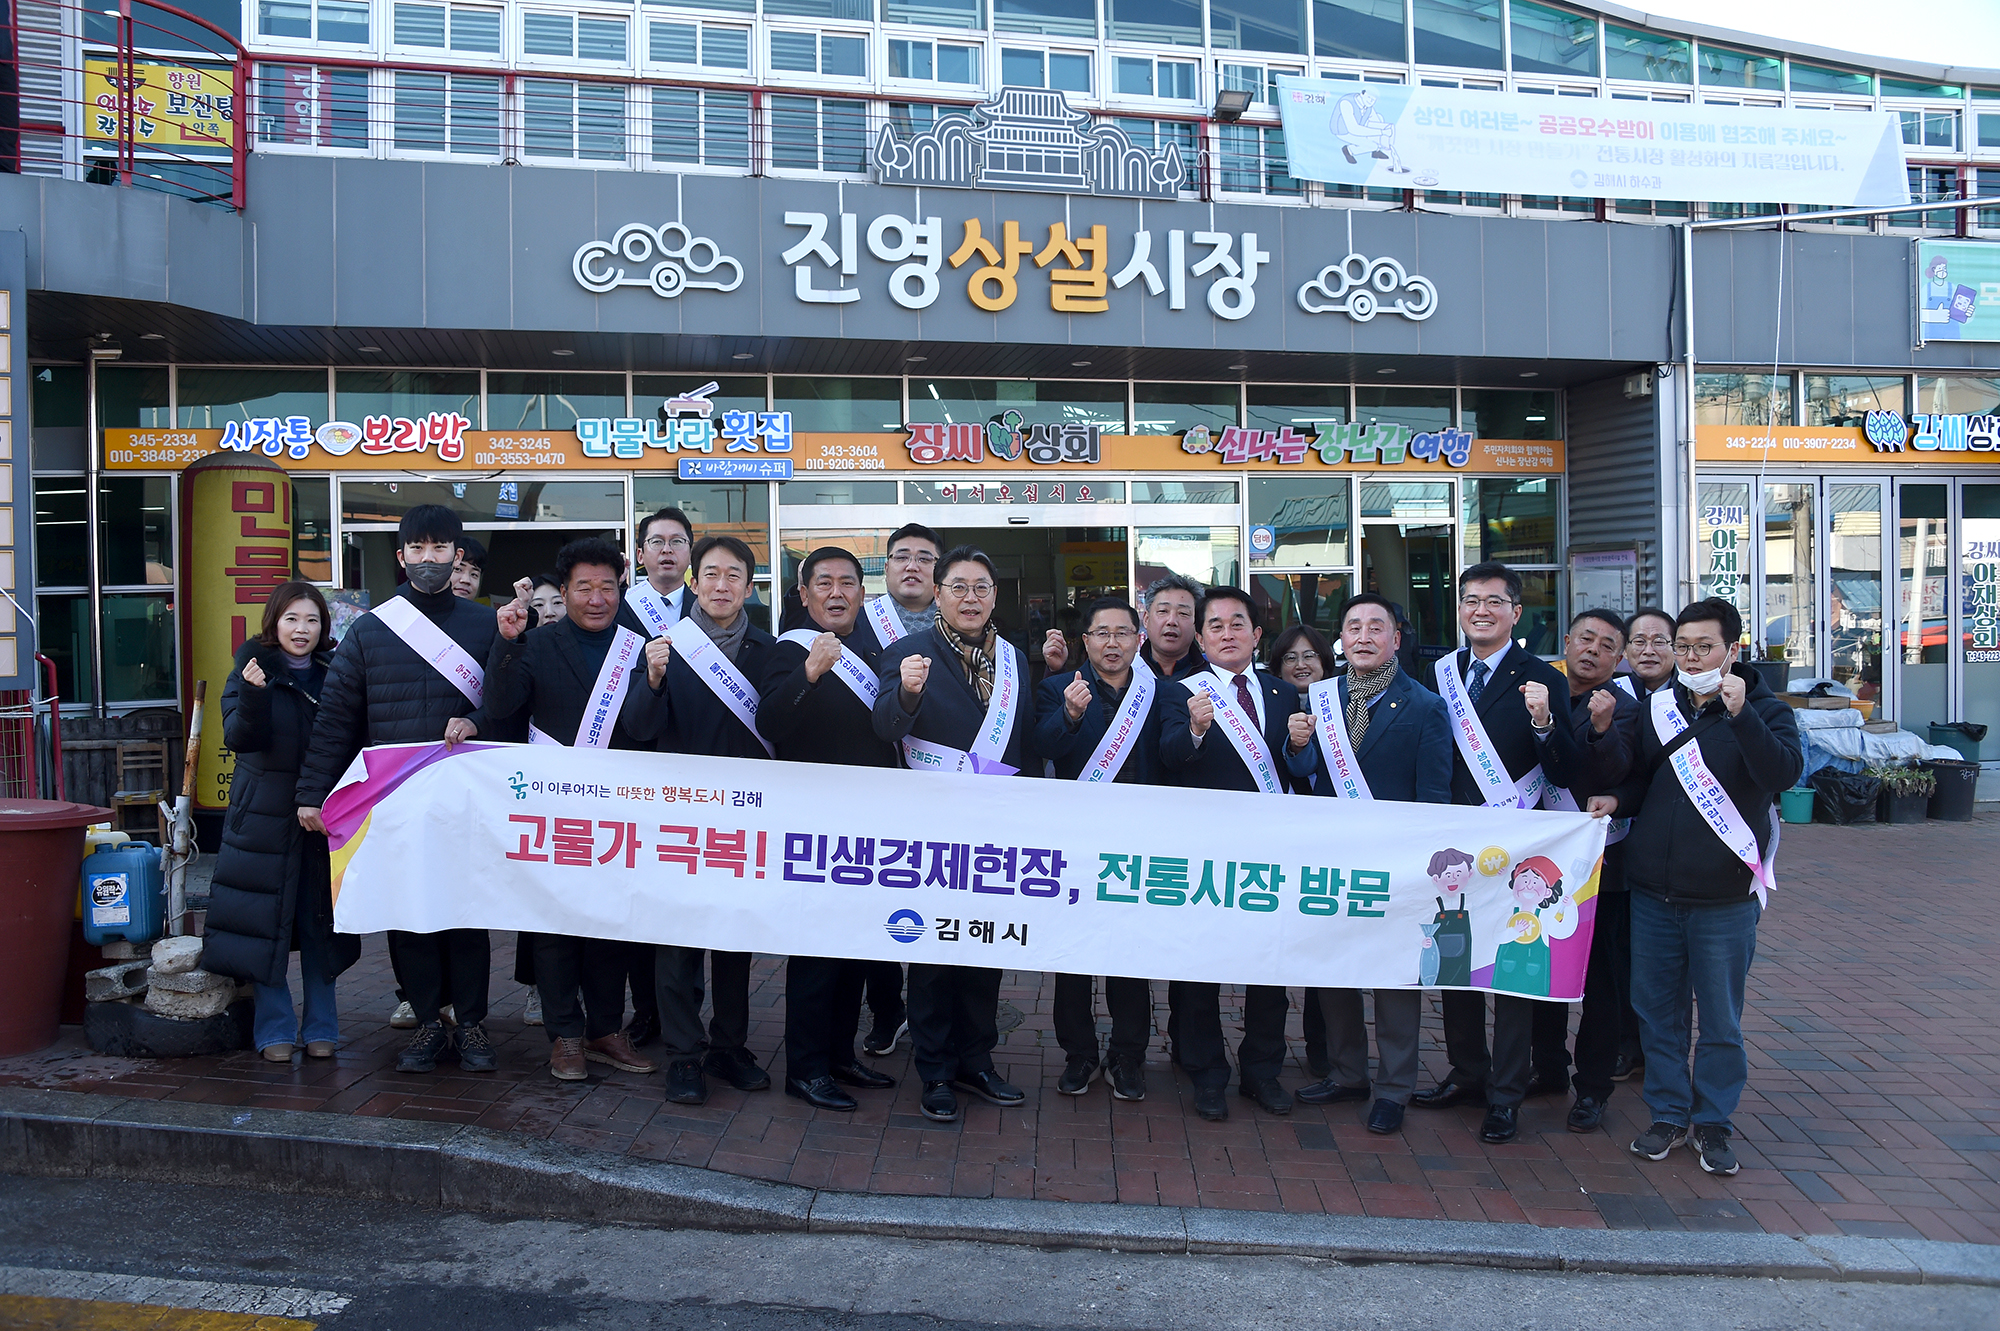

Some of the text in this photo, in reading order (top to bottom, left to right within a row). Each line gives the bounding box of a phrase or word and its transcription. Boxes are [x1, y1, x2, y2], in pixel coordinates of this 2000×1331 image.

[167, 71, 201, 90] 향원
[165, 93, 233, 121] 보신탕
[192, 121, 219, 136] 안쪽
[1413, 105, 1847, 147] 상인 여러분~ 공공오수받이 이용에 협조해 주세요~
[1488, 139, 1521, 157] 시장
[1596, 145, 1664, 166] 전통시장
[1669, 149, 1736, 168] 활성화의
[1742, 151, 1845, 172] 지름길입니다.
[1594, 173, 1662, 189] 김해시 하수과
[781, 210, 1270, 321] 진영상설시장
[129, 433, 198, 447] 345-2334
[221, 412, 471, 461] 시장통 보리밥
[489, 437, 552, 450] 342-3245
[577, 410, 793, 458] 민물나라 횟집
[905, 423, 1101, 463] 장씨 상회
[1726, 437, 1856, 450] 343-2234 010-3907-2234
[1912, 413, 2000, 451] 강씨상
[110, 448, 216, 463] 010-3848-233
[820, 446, 878, 458] 343-3604
[1215, 422, 1474, 467] 신나는 장난감 여행
[1526, 445, 1553, 455] 함께하는
[475, 452, 565, 466] 010-3553-0470
[706, 460, 786, 476] 바람개비 슈퍼
[806, 458, 886, 470] 010-9206-3604
[1495, 456, 1553, 467] 신나는 장난감 여행
[942, 484, 1095, 503] 어서오십시오
[1705, 506, 1743, 526] 강씨
[1969, 541, 2000, 559] 강씨
[1972, 563, 1997, 648] 야채상회
[1967, 651, 2000, 662] T:343-223
[839, 655, 866, 683] 가안정을
[1318, 691, 1333, 723] 우리동네
[1325, 723, 1350, 778] 착한가격업소
[1476, 750, 1502, 786] 생활수칙
[547, 781, 611, 798] 이루어지는
[616, 786, 656, 801] 따뜻한
[662, 785, 725, 806] 행복도시
[731, 790, 763, 808] 김해
[505, 812, 1391, 919] 고물가 극복! 민생경제현장, 전통시장 방문
[935, 917, 1029, 947] 김해시
